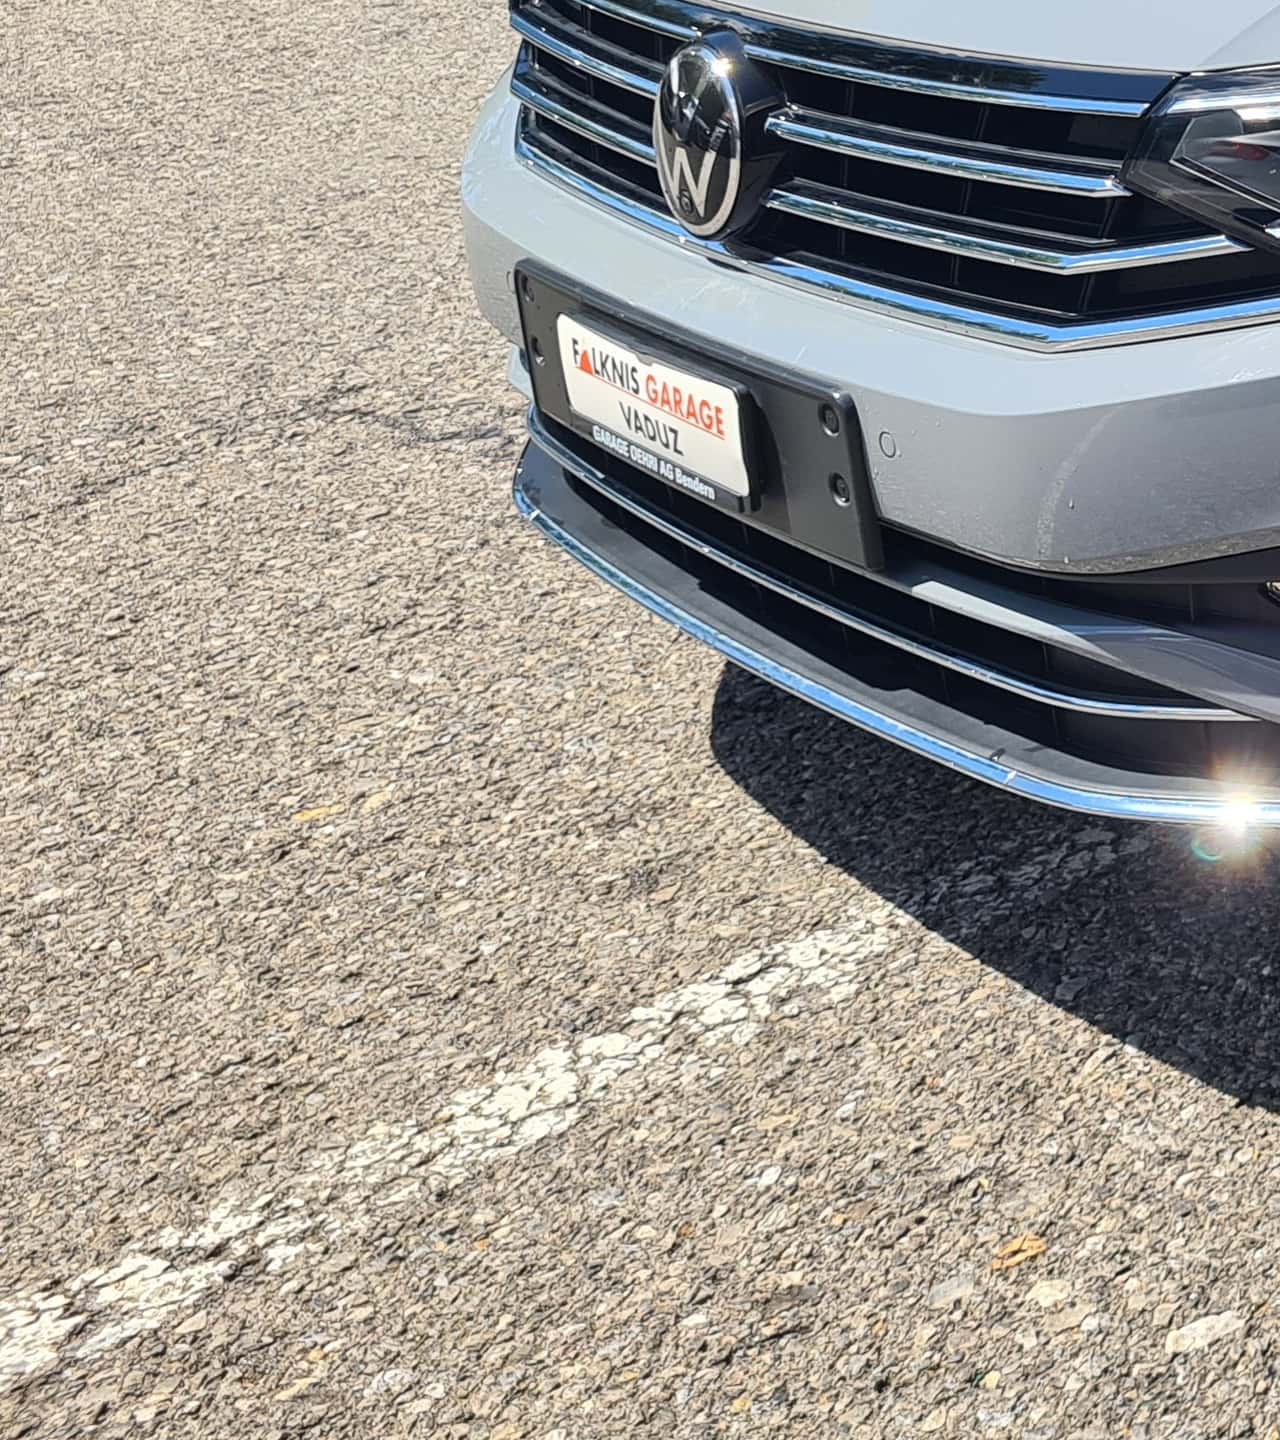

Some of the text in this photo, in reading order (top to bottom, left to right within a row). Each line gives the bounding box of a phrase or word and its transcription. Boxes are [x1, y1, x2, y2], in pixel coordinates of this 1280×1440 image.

[618, 400, 685, 457] VADUZ
[645, 373, 726, 437] GARAGE
[592, 424, 630, 458] GARAGE
[659, 460, 675, 481] AG
[674, 467, 716, 501] Bendern
